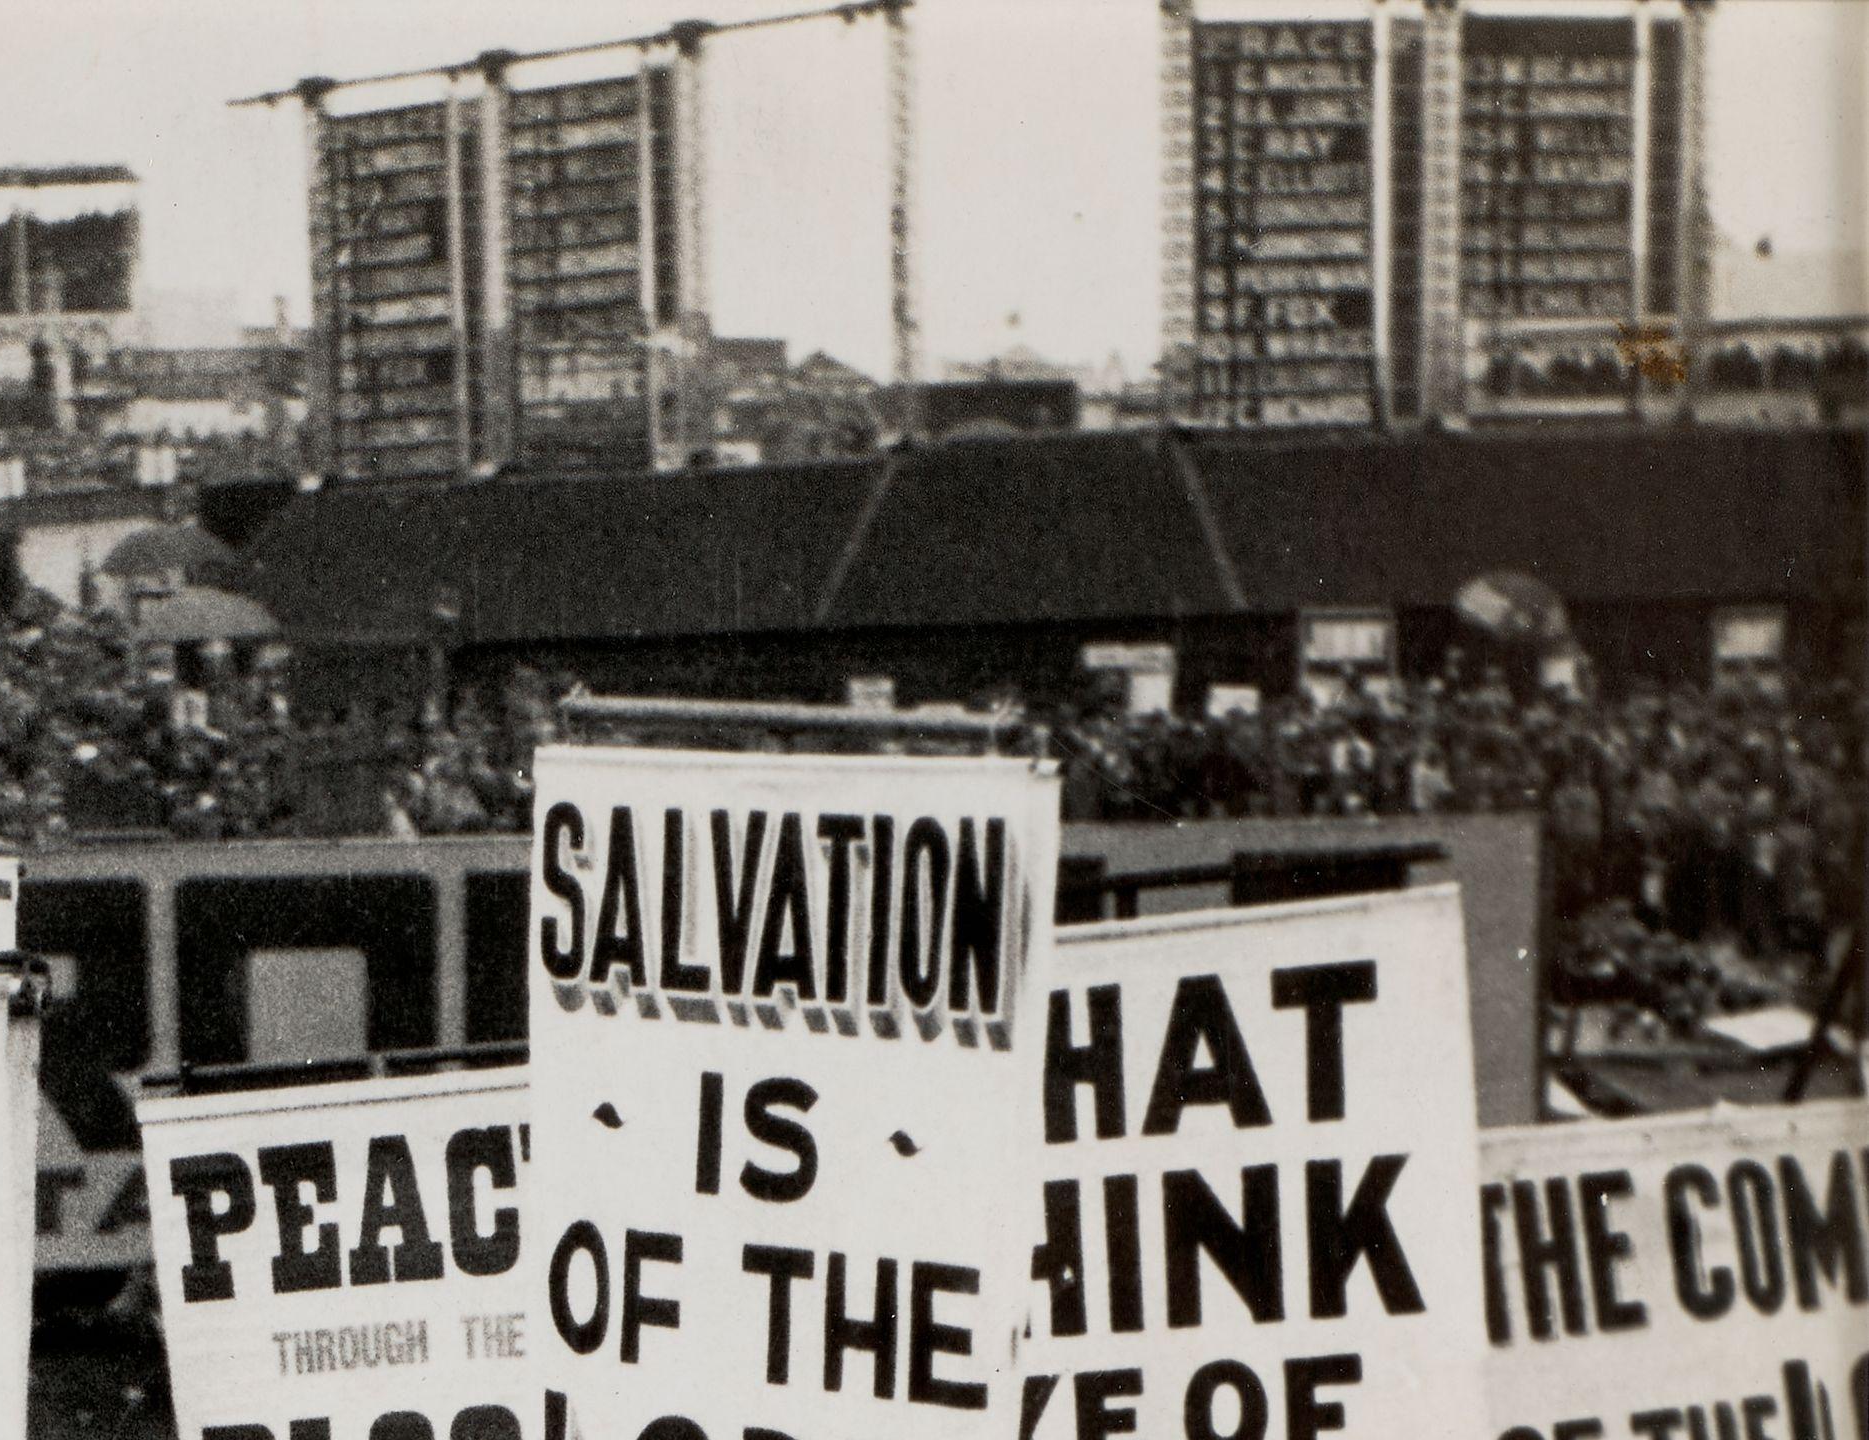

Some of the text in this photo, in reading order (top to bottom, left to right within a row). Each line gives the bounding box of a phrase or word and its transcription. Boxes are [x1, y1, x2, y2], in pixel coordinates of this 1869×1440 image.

[539, 802, 1011, 1022] SALVATION
[695, 1070, 820, 1203] IS
[1043, 960, 1379, 1146] HAT
[169, 1122, 531, 1304] PEAC
[1029, 1153, 1427, 1339] HINK
[1665, 1148, 1867, 1321] COM
[272, 1312, 527, 1375] THROUGH THE
[548, 1217, 989, 1411] OF THE
